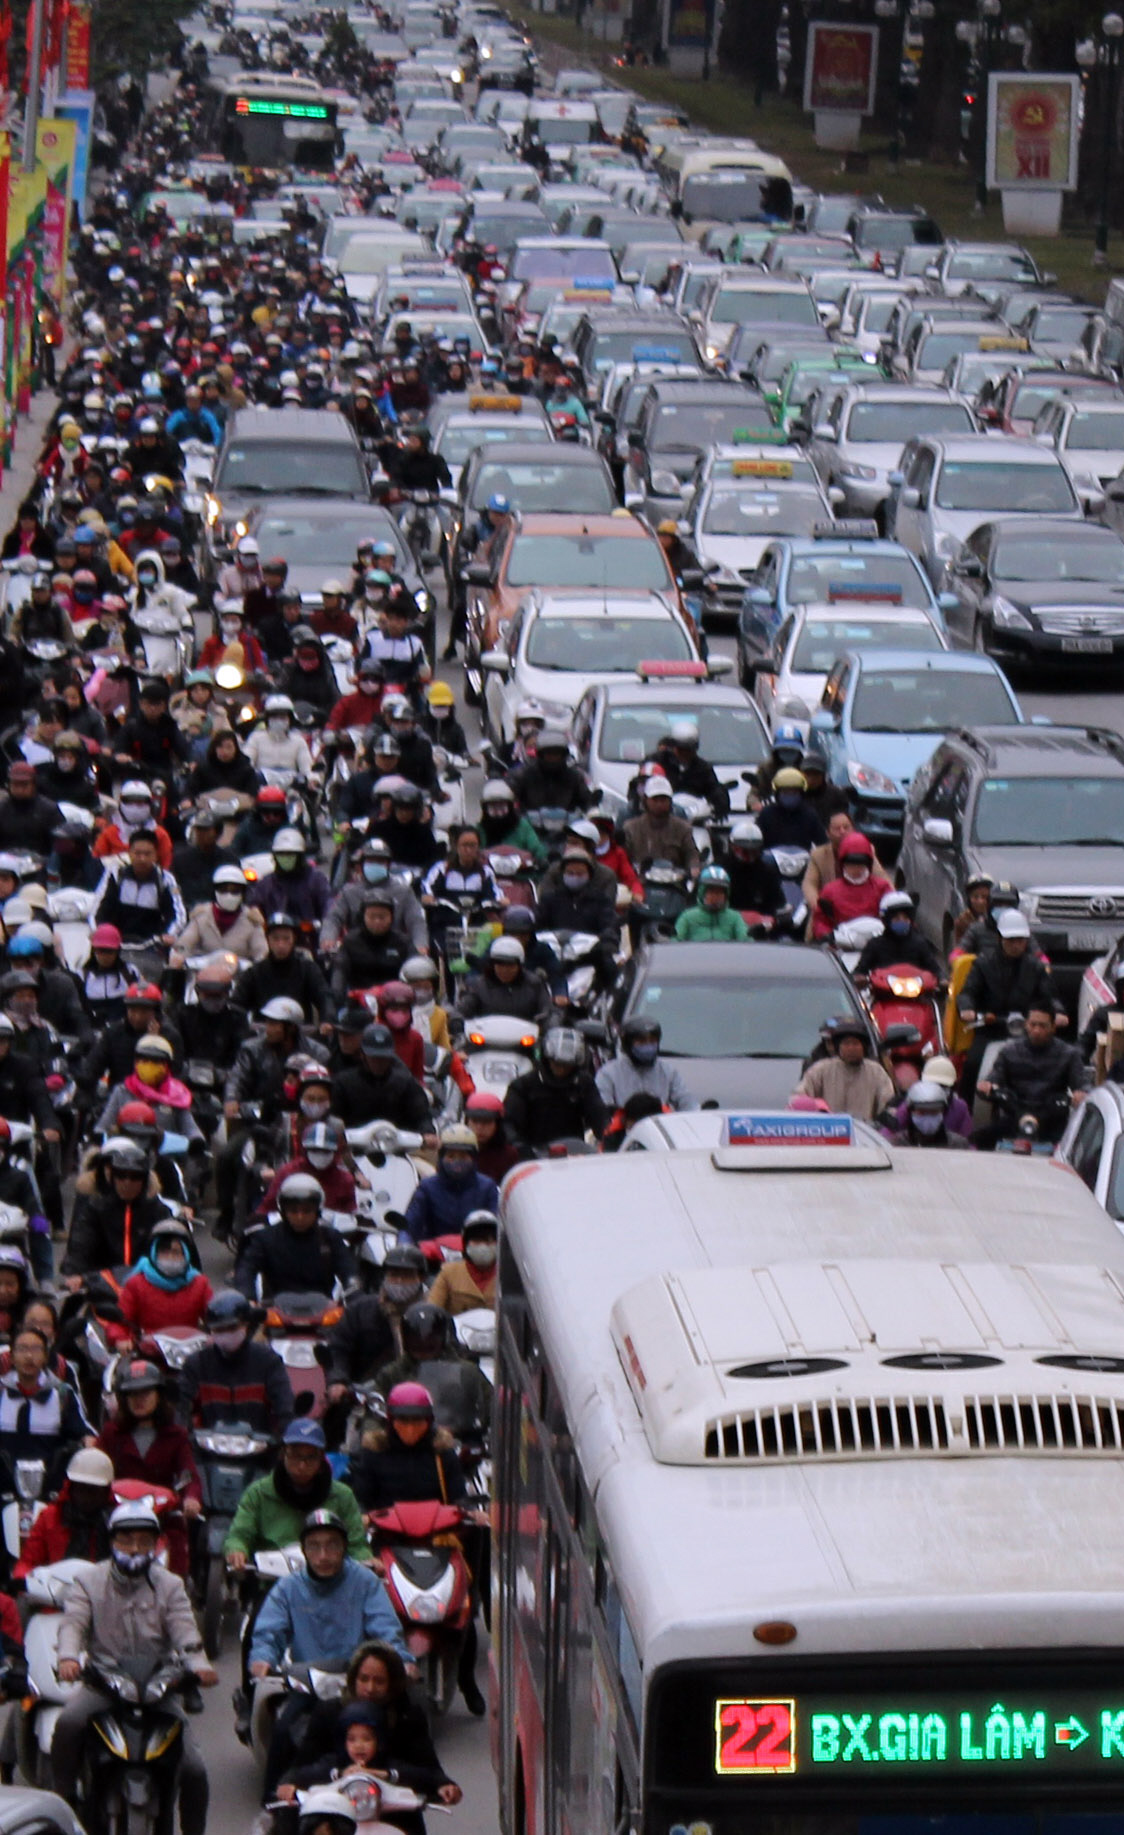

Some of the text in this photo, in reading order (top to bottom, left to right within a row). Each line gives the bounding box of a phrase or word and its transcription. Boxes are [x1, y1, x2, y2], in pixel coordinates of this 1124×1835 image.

[745, 1122, 848, 1138] TAXIGROUP
[720, 1704, 791, 1767] 22
[811, 1713, 947, 1762] BX.GIA
[959, 1702, 1046, 1760] LÂM
